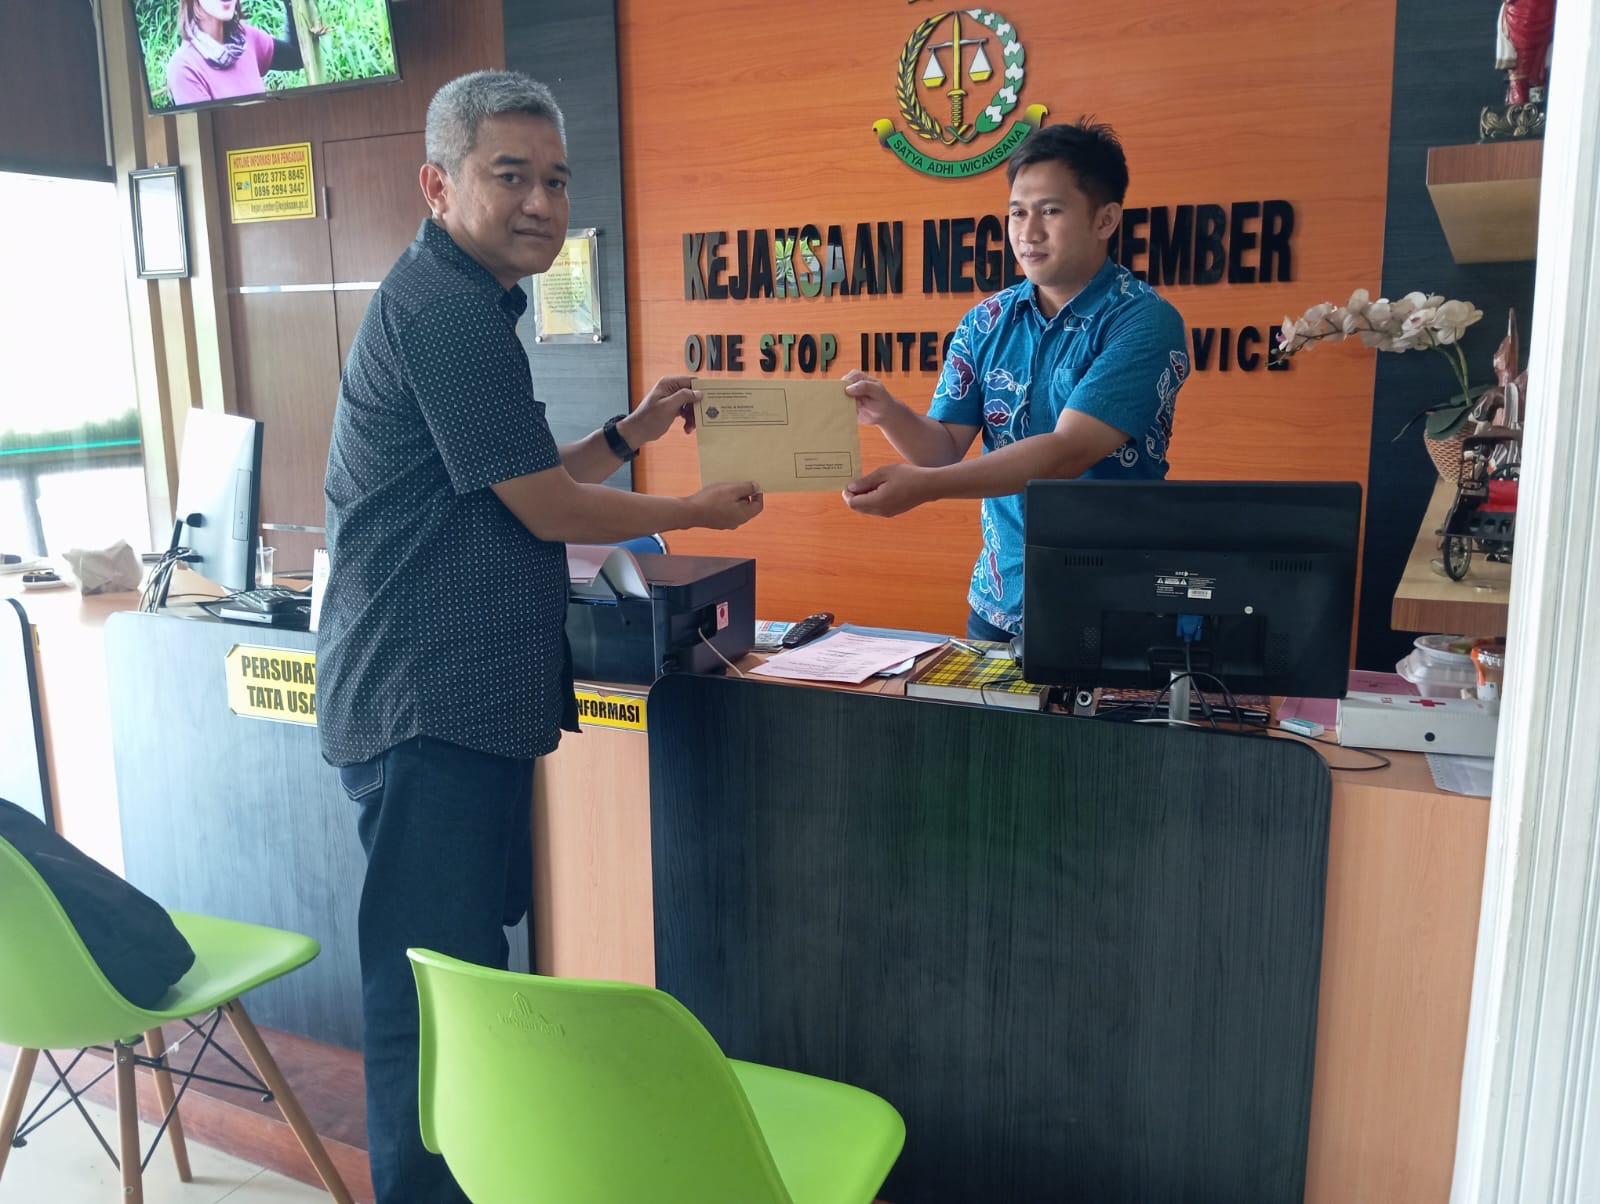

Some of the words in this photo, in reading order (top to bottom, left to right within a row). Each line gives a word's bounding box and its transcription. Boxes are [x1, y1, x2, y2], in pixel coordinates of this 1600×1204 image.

[893, 139, 923, 167] SATYA
[927, 161, 954, 175] ADHI
[960, 129, 1025, 173] WICAKSANA
[253, 172, 269, 184] 0822
[270, 170, 287, 182] 3775
[289, 182, 305, 194] 3447
[682, 220, 903, 301] KEJAKSAAN
[1108, 200, 1295, 287] EMBER
[685, 334, 744, 373] ONE
[759, 333, 838, 373] STOP
[241, 655, 316, 685] PERSURA
[246, 685, 285, 711] TATA
